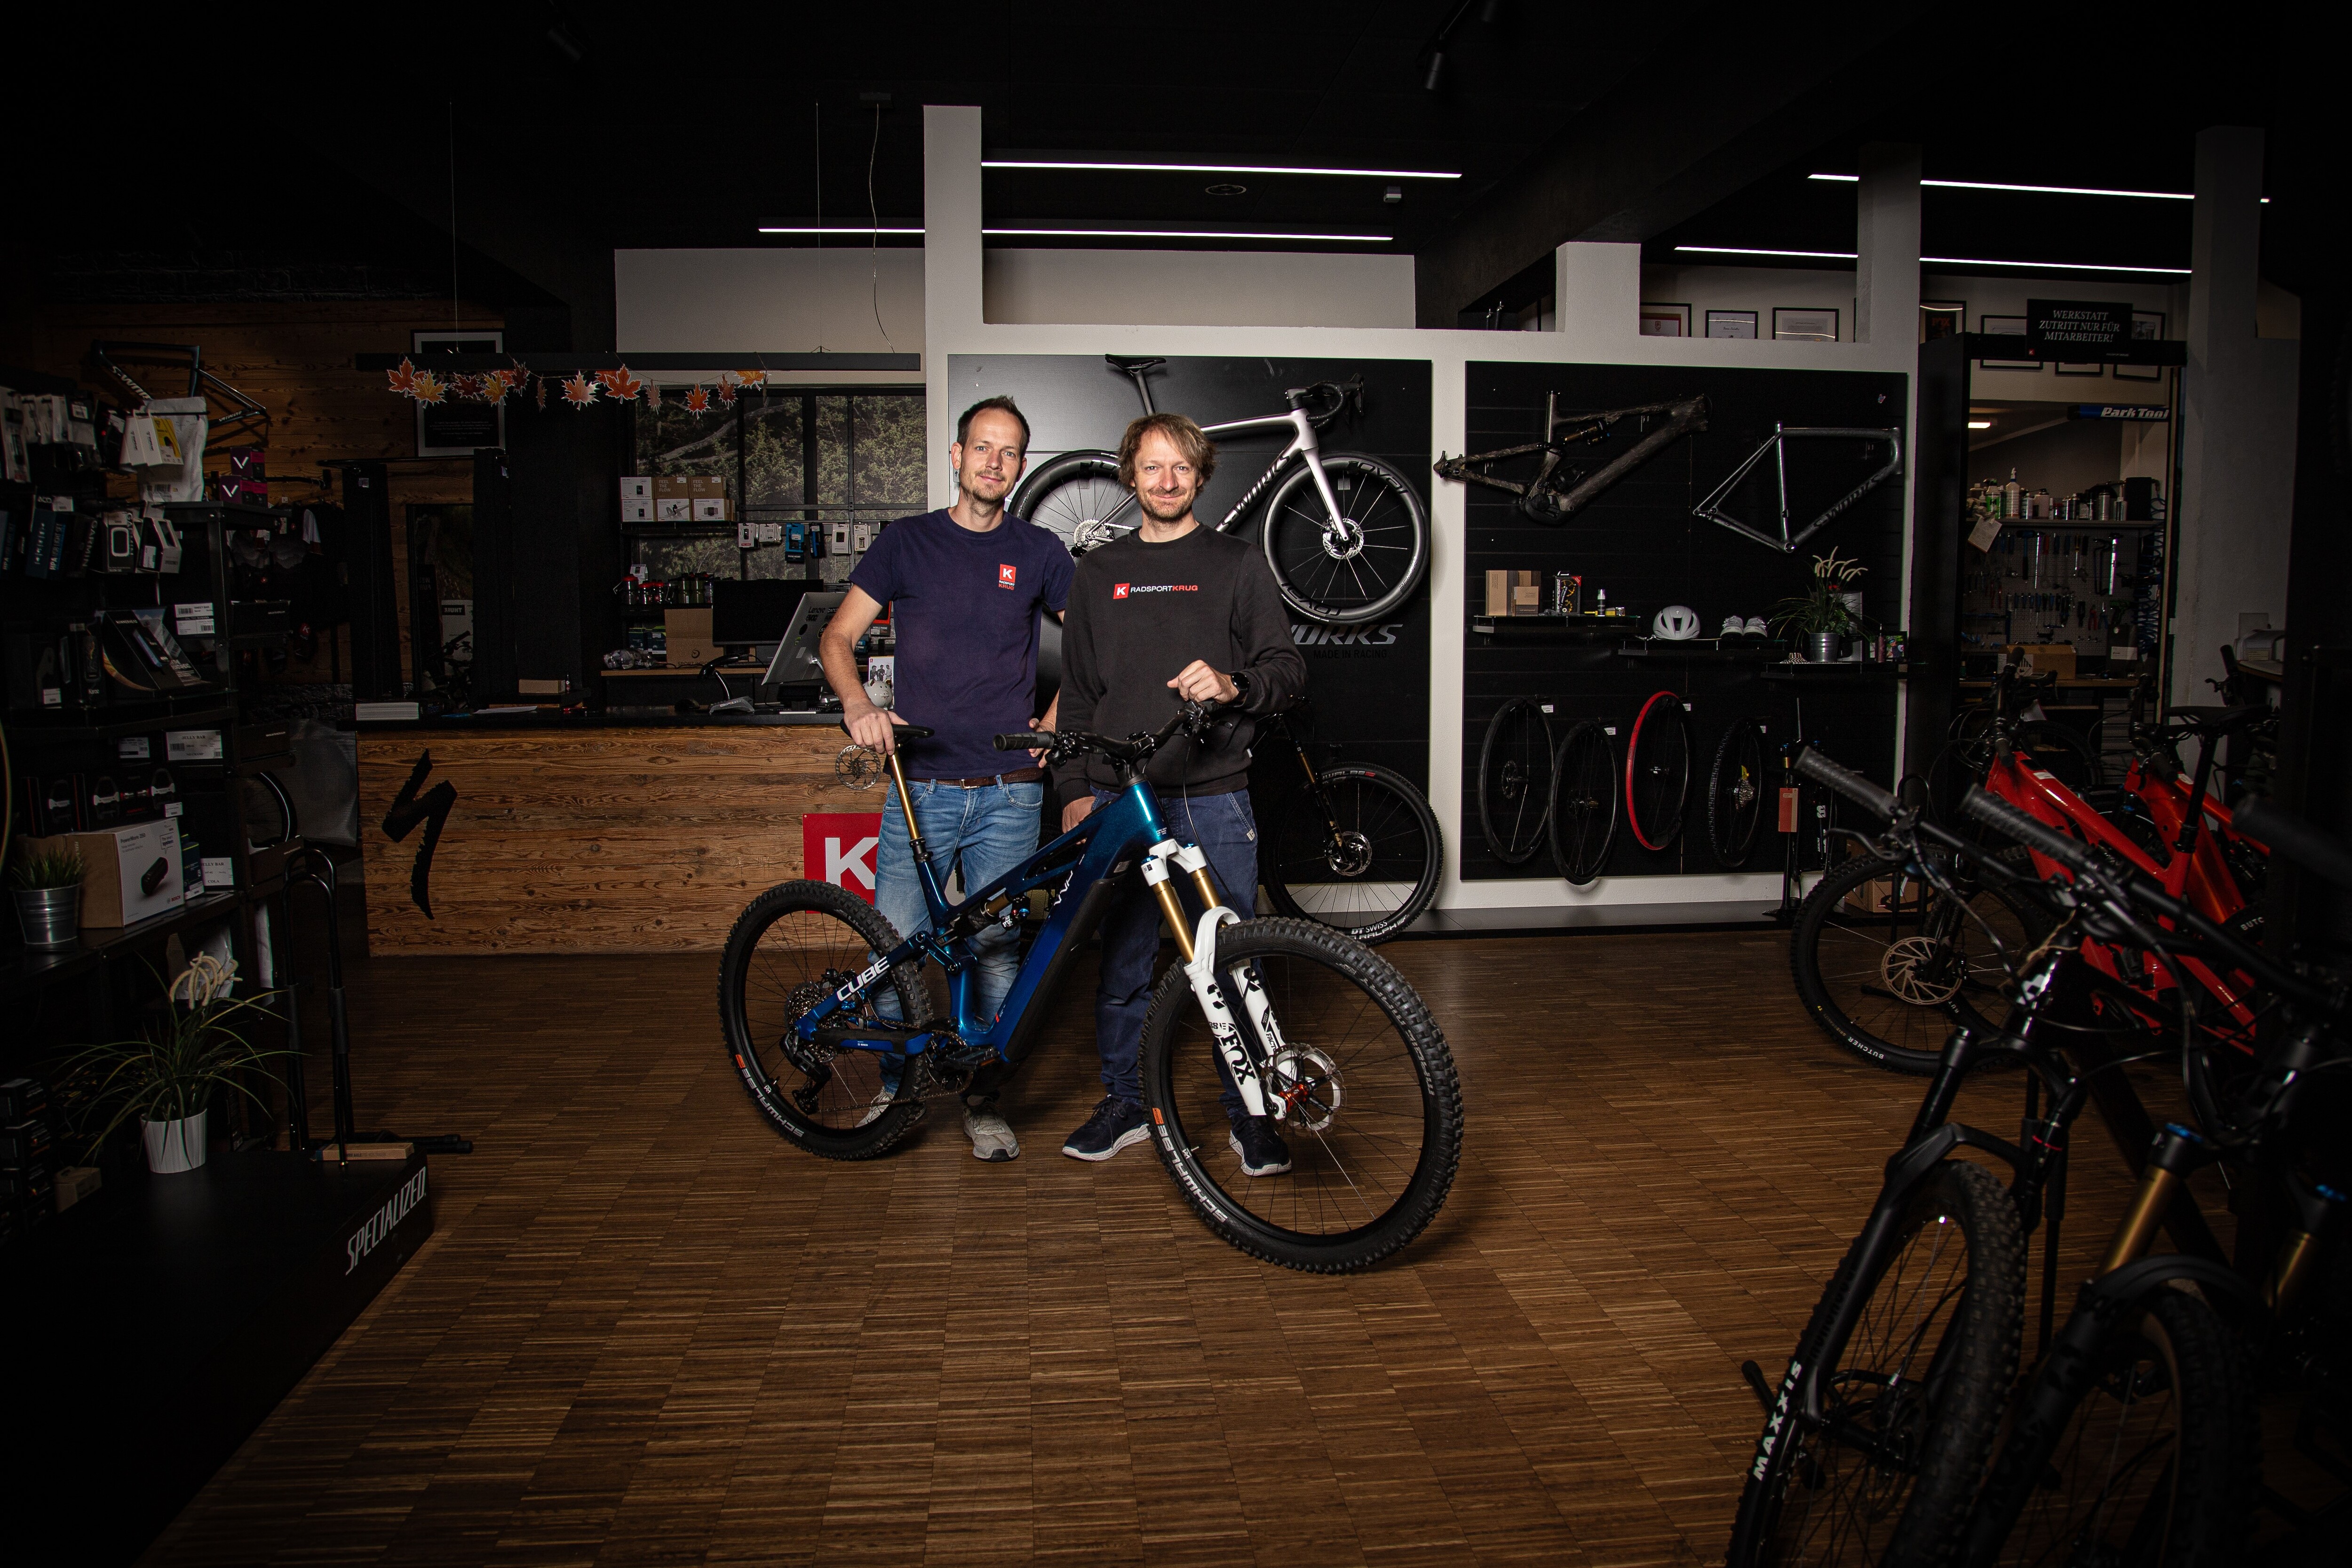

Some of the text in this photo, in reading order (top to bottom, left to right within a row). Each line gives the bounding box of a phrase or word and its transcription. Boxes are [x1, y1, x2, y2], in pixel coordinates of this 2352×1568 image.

[2052, 310, 2109, 321] WERKSTATT
[2038, 320, 2121, 332] ZUTRITT NUR FÜR
[2044, 331, 2114, 342] MITARBEITER!
[2100, 406, 2170, 419] Park Tool
[1221, 454, 1291, 528] S-WORKS
[1002, 568, 1013, 580] K
[1116, 586, 1127, 596] K
[1313, 649, 1387, 659] MADE IN RACING
[825, 836, 880, 890] K
[1359, 923, 1397, 940] RALPH
[1365, 920, 1388, 933] SWISS
[836, 956, 890, 1002] CUBE
[1848, 1036, 1884, 1059] BUTCHER
[1220, 1031, 1256, 1085] FOX
[741, 1067, 805, 1138] SCHWALBE
[1157, 1125, 1228, 1223] SCHWALBE
[345, 1166, 426, 1276] SPECIALIZED
[1752, 1360, 1804, 1481] MAXXIS
